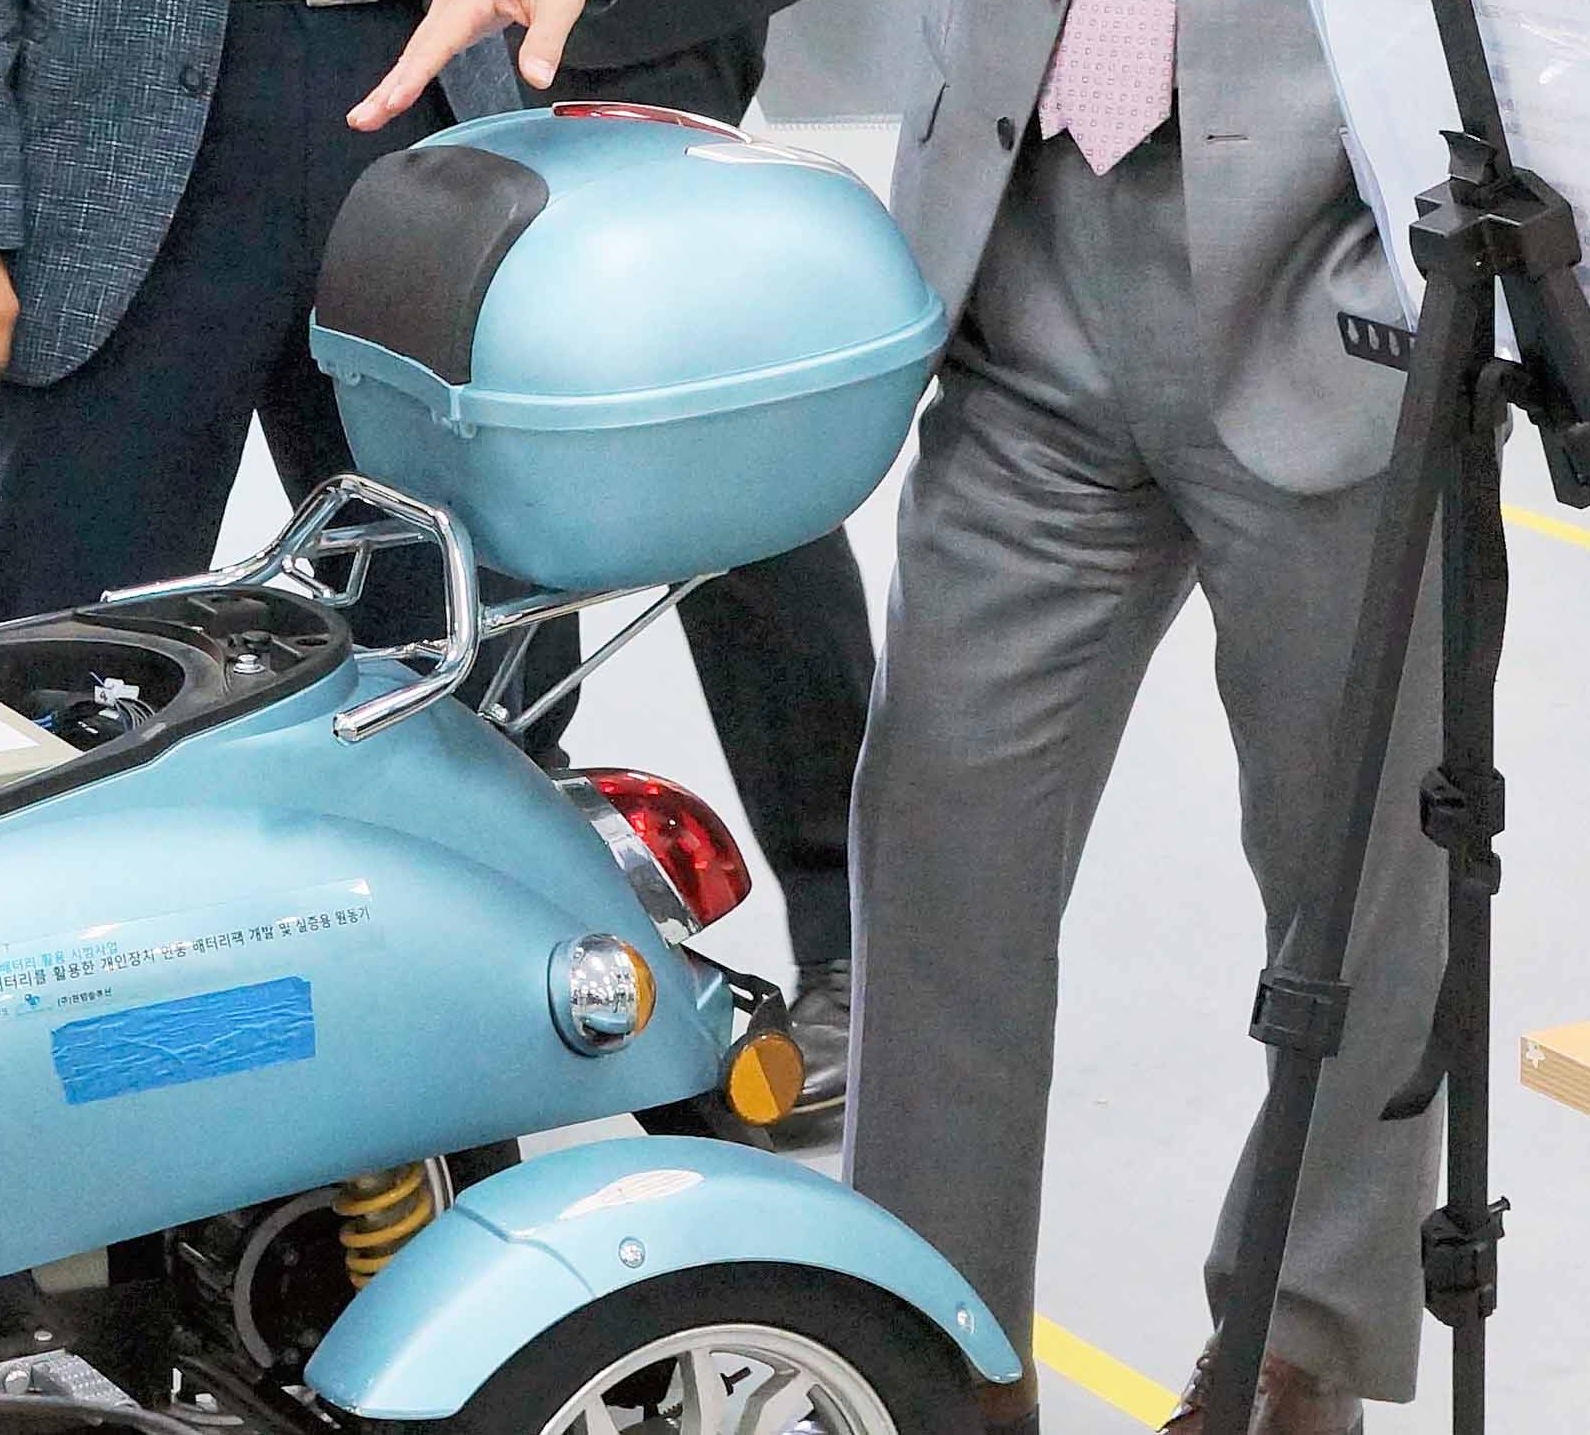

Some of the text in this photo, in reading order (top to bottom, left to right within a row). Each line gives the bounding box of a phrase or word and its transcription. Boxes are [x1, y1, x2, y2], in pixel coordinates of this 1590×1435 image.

[53, 960, 95, 982] 활용한
[101, 949, 155, 972] 개인장치
[192, 930, 244, 954] 배터리팩
[248, 925, 275, 942] 개발
[278, 922, 292, 937] 및
[295, 912, 332, 934] 실증용
[334, 905, 371, 926] 원동기
